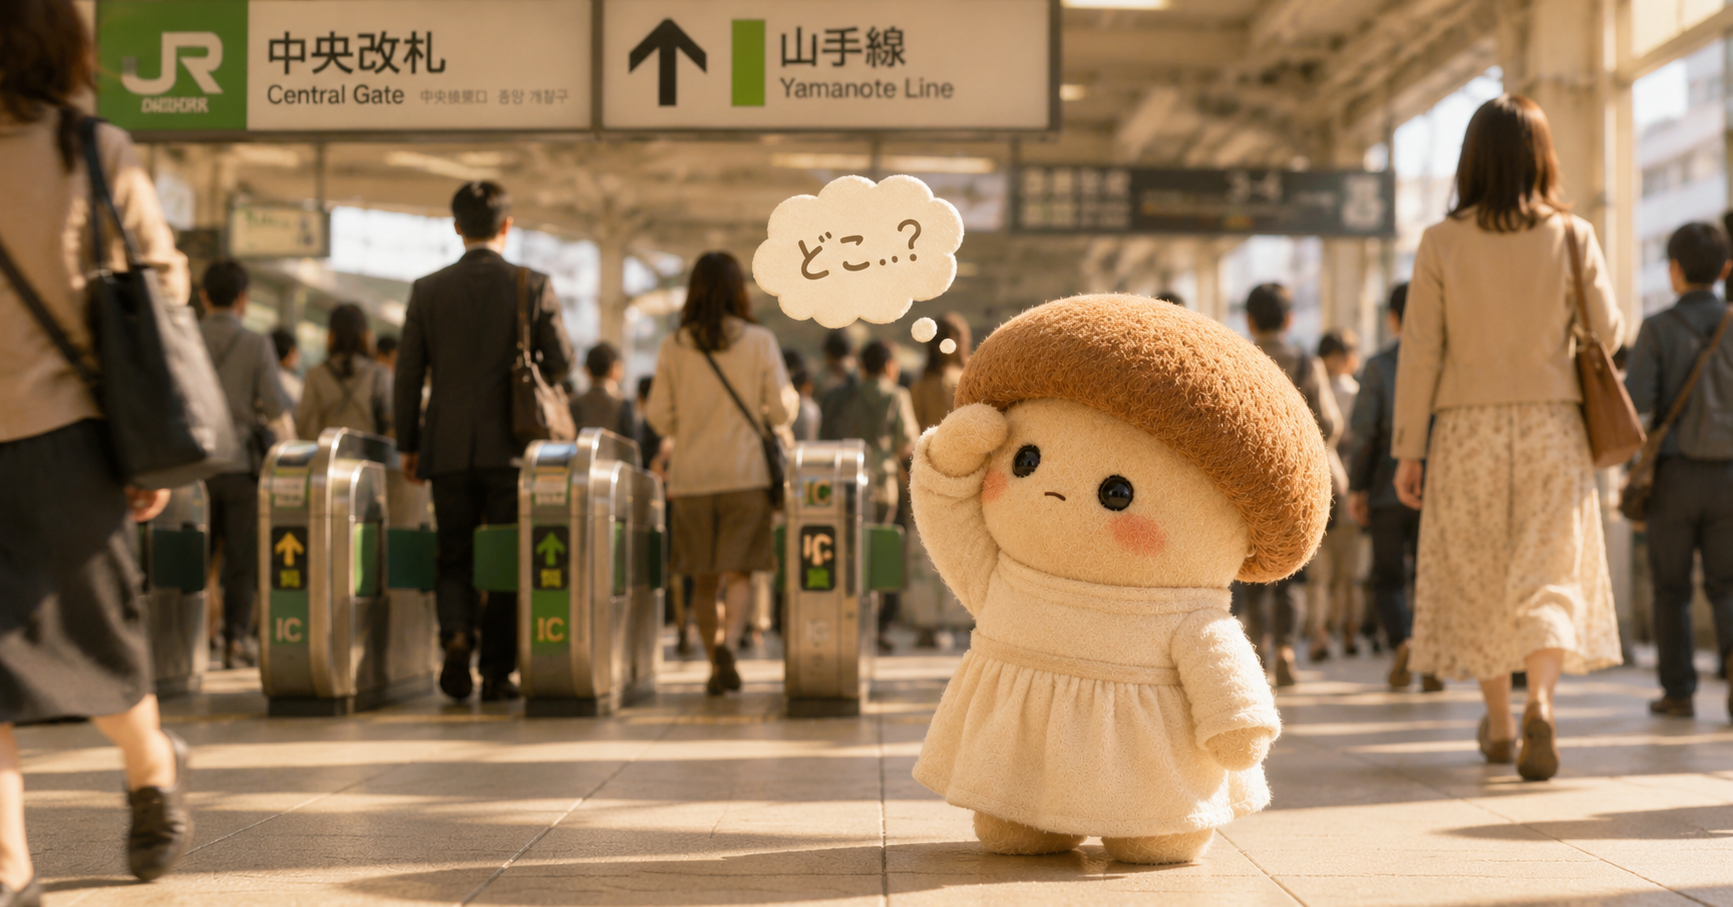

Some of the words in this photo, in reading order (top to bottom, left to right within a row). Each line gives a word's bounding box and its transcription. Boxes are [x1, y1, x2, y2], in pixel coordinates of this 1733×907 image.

[268, 31, 446, 75] 中央改札
[780, 26, 906, 68] 山手線
[121, 31, 224, 95] JR
[267, 84, 345, 105] Central
[353, 84, 405, 105] Gate
[779, 77, 897, 99] Yamanote
[904, 77, 954, 99] Line
[275, 617, 303, 642] IC
[537, 616, 565, 642] IC
